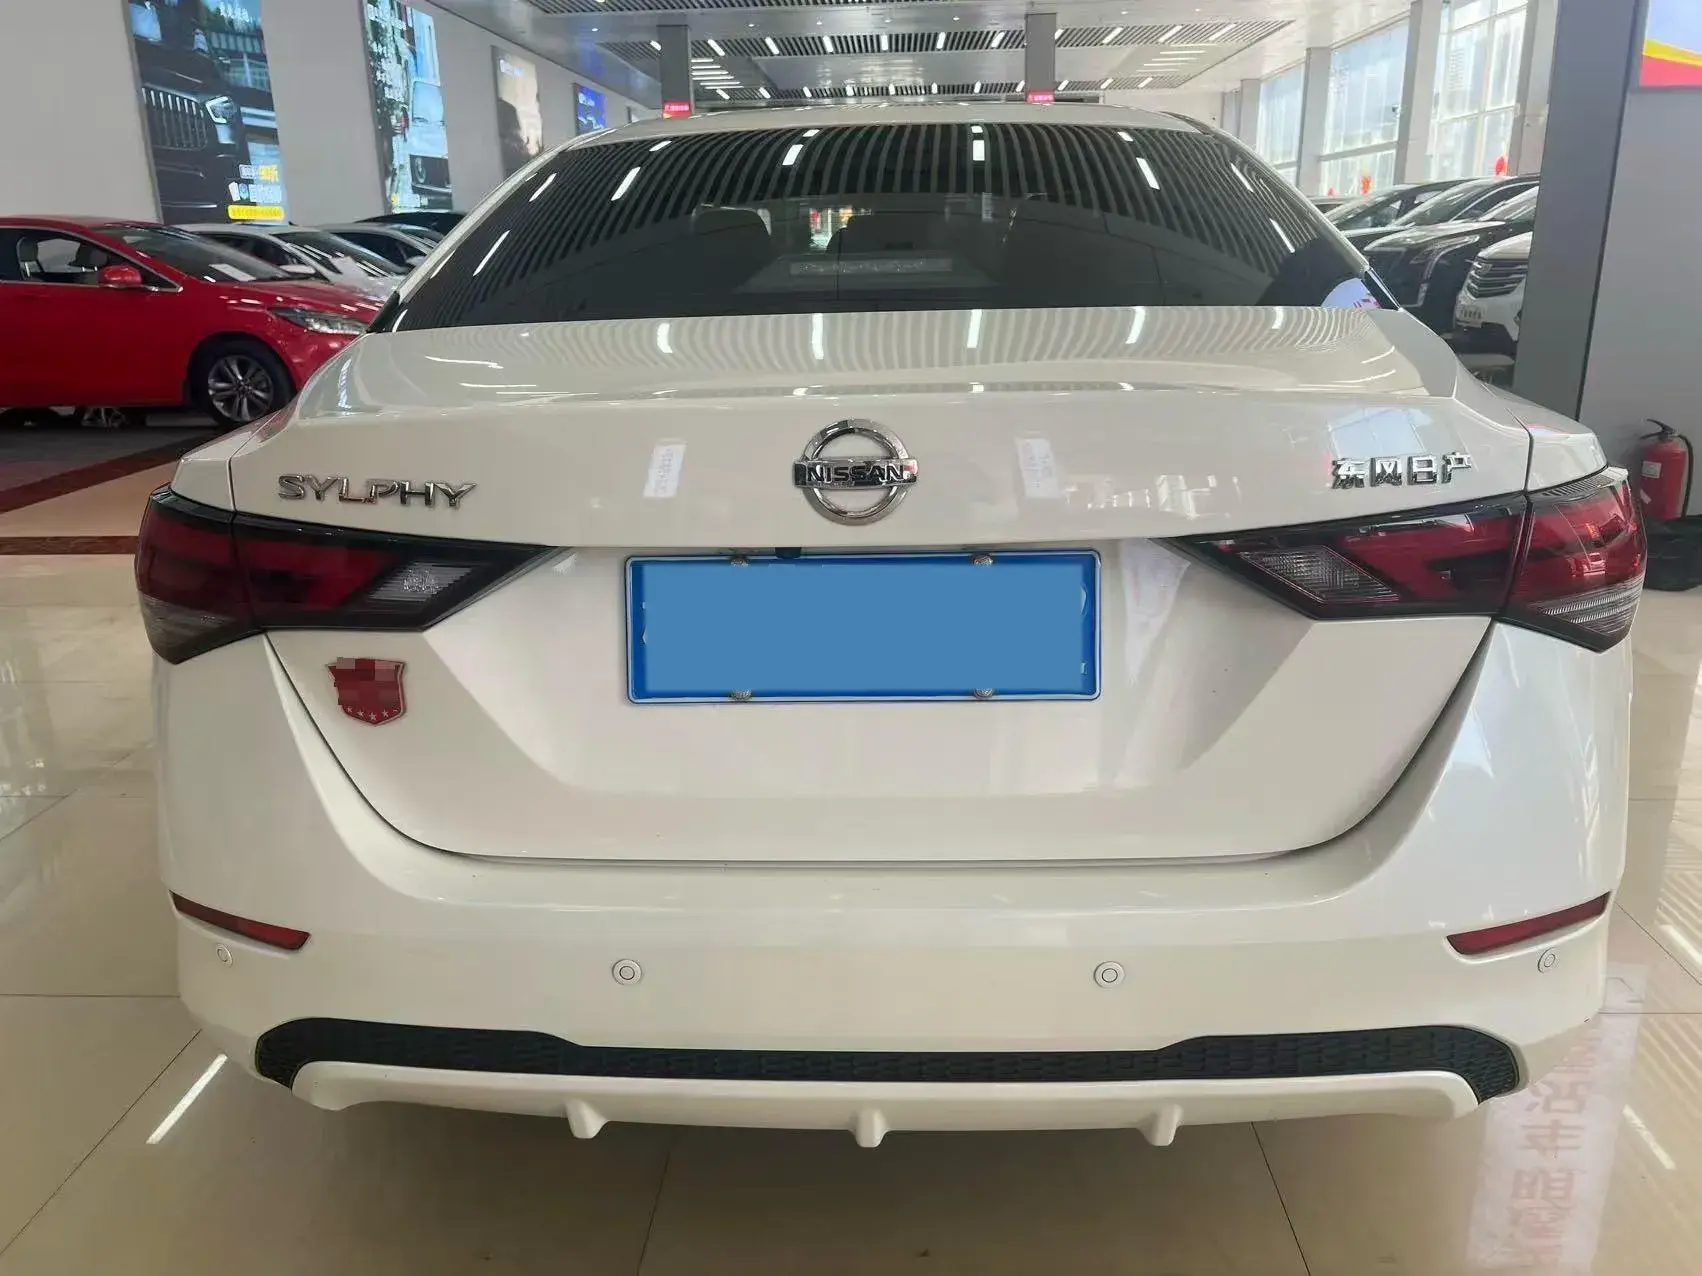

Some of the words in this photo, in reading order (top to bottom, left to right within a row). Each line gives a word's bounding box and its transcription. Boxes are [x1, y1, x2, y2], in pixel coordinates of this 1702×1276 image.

[807, 465, 903, 482] NISSAN
[1331, 452, 1471, 489] 东风日产
[278, 474, 477, 507] SYLPHY
